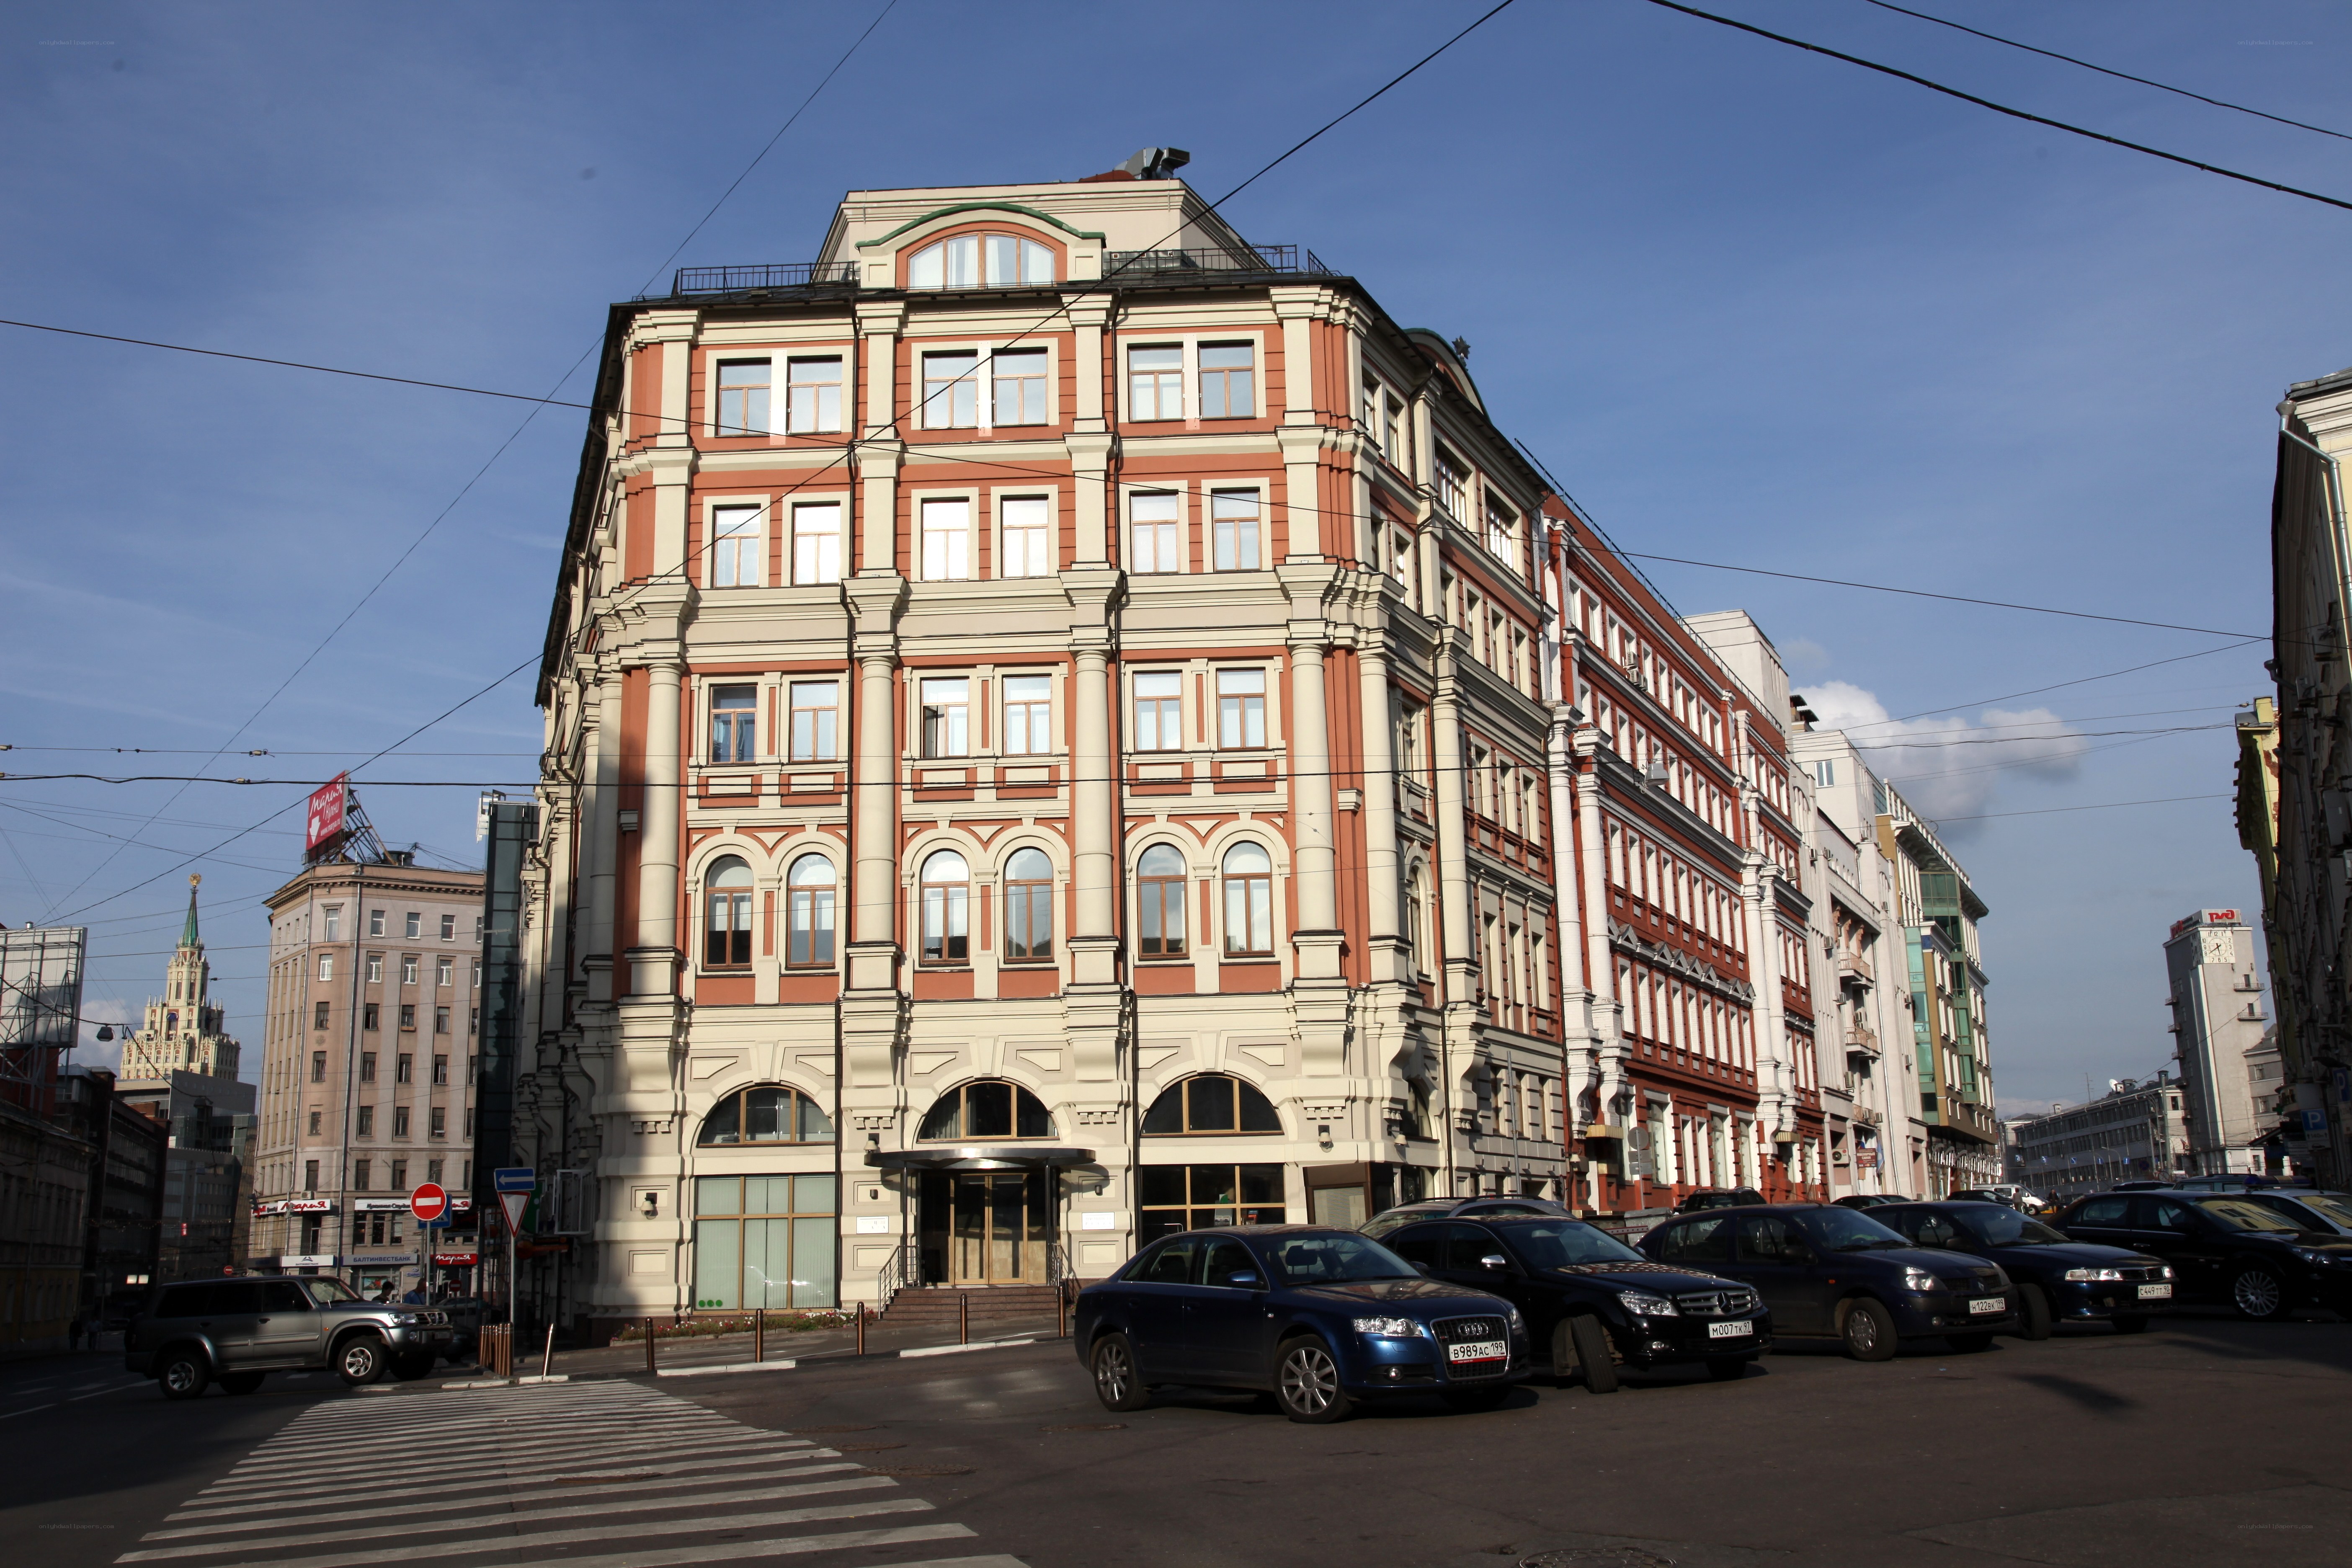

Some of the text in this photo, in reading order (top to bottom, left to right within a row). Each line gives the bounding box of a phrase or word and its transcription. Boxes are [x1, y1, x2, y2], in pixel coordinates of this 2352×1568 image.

[320, 818, 341, 837] www.marya.ru
[2307, 1112, 2321, 1129] P
[1972, 1301, 1995, 1311] Н122ВК
[1712, 1324, 1743, 1336] М007ТК
[1453, 1342, 1503, 1358] В989АС 199
